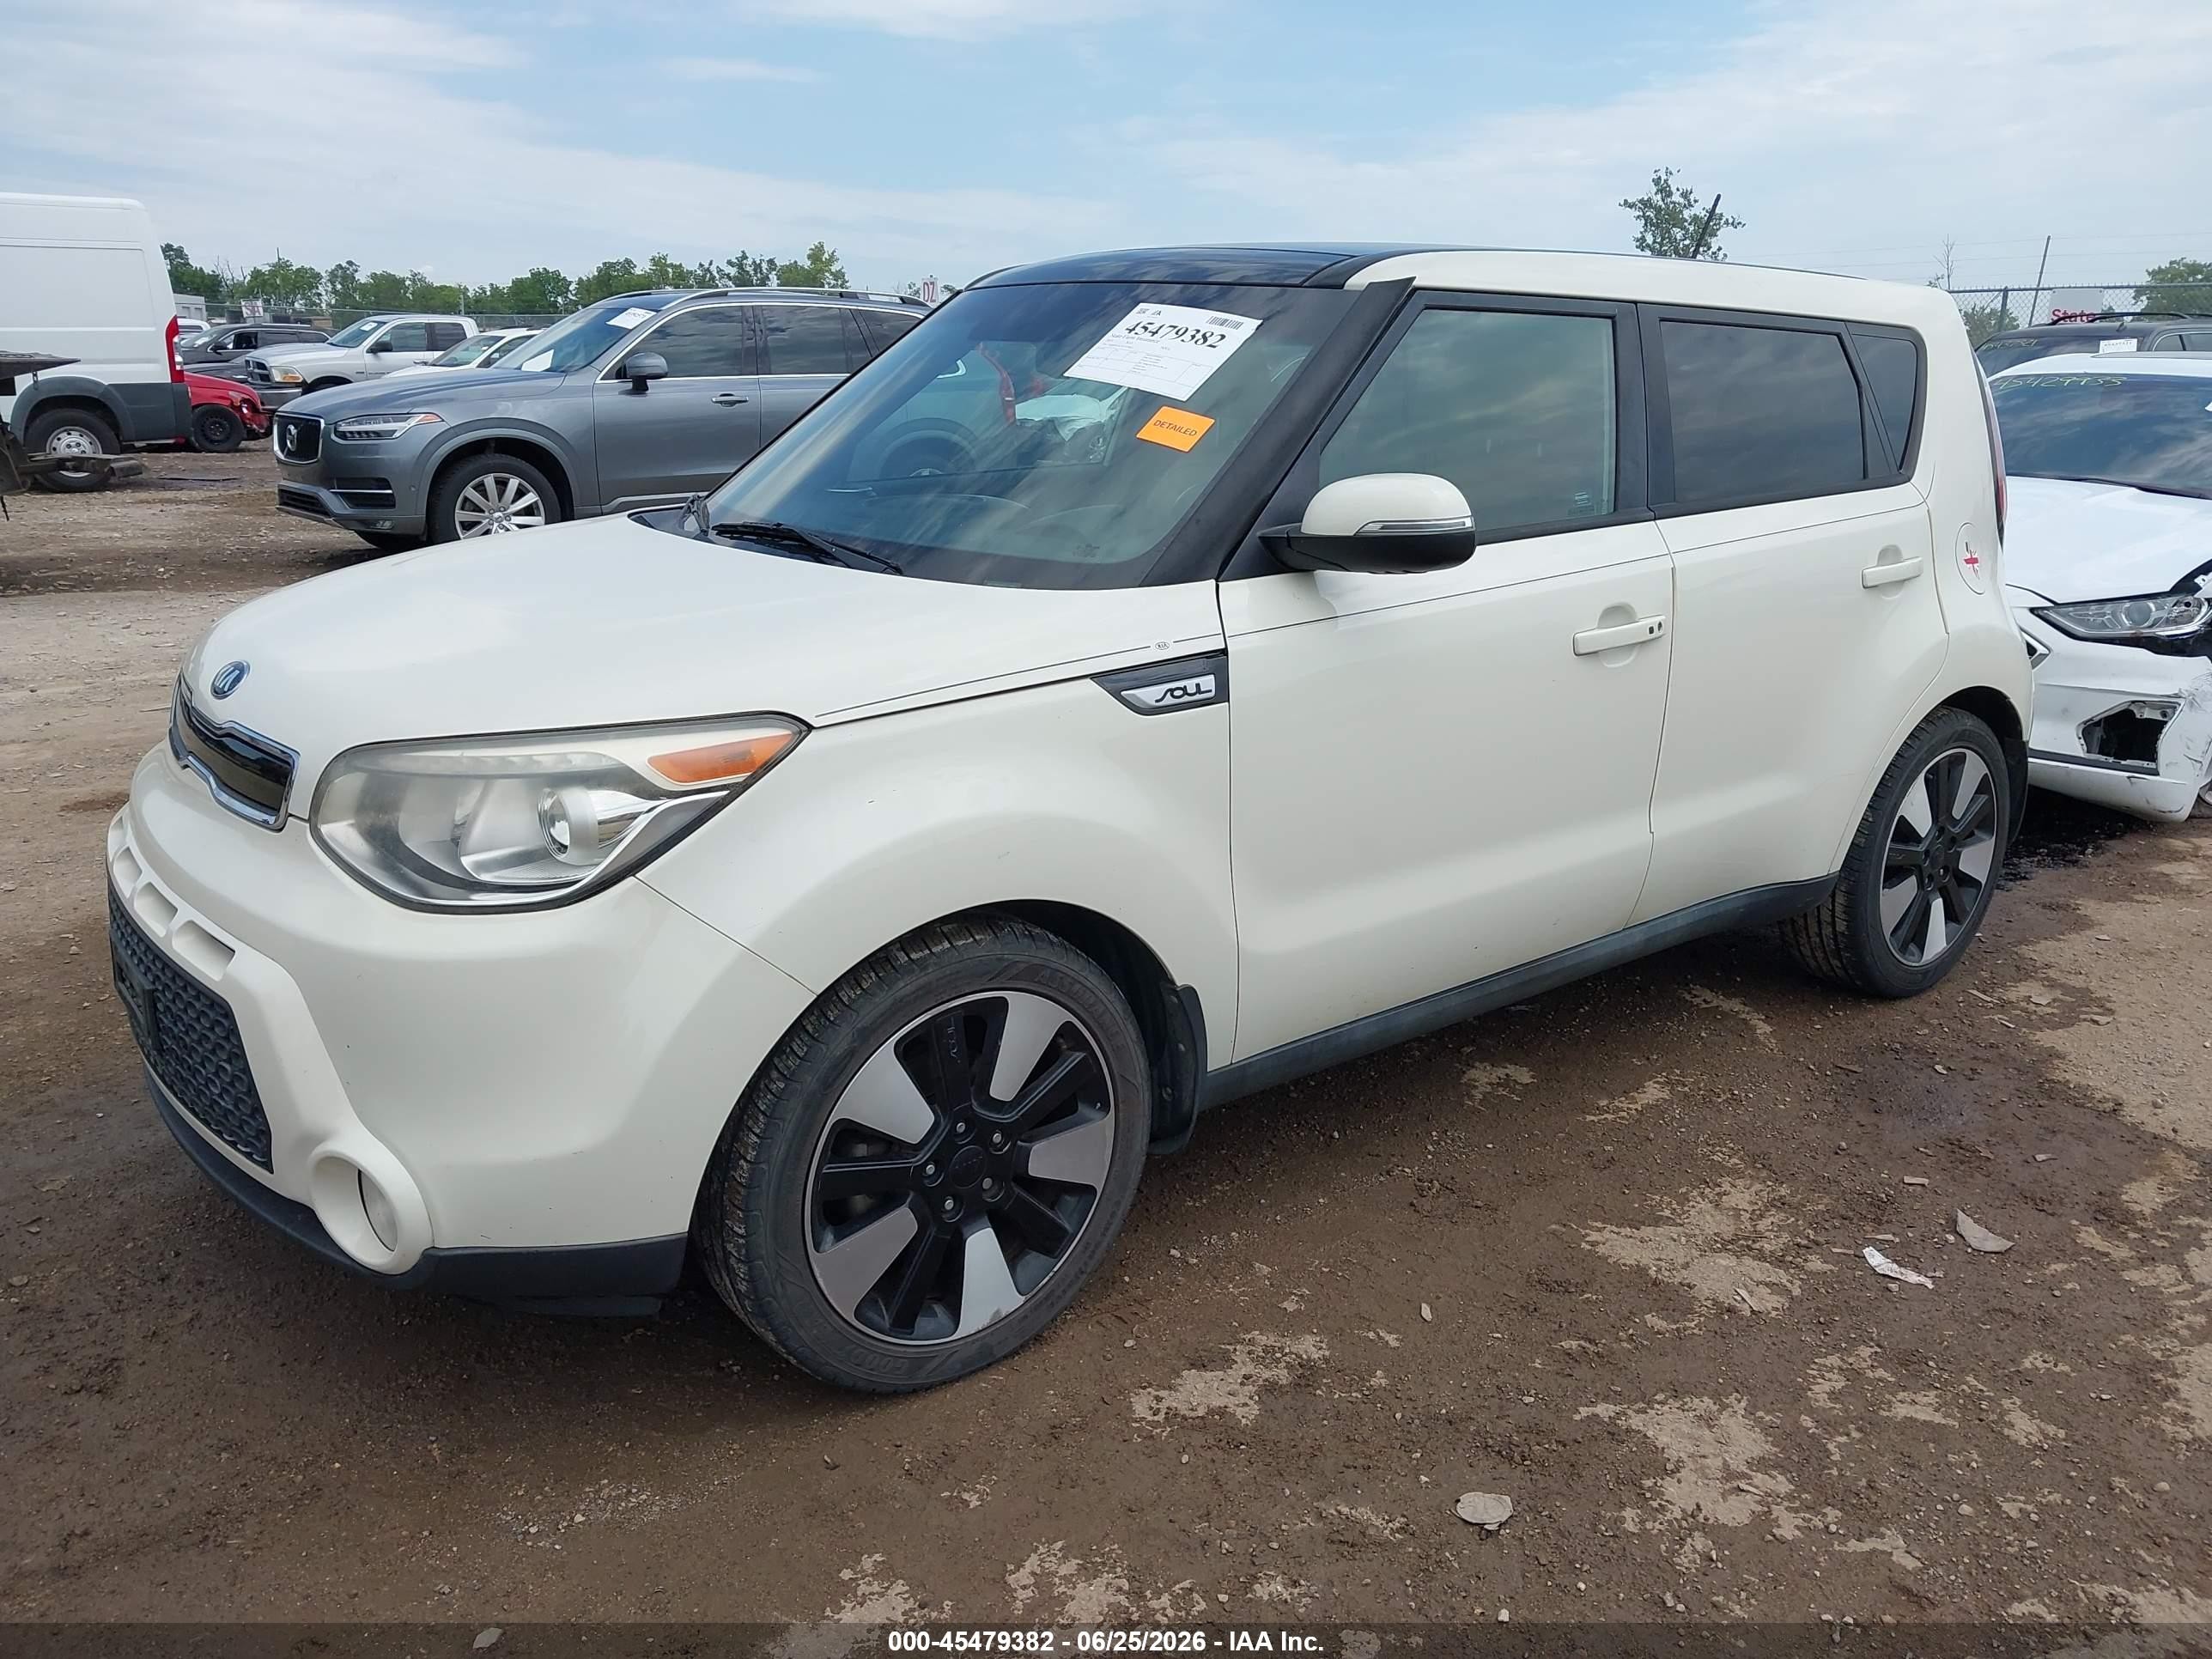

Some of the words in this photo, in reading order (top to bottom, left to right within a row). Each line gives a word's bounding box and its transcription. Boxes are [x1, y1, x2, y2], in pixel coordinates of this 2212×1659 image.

[1124, 320, 1227, 349] 45479382
[1152, 419, 1198, 438] DETAILED
[1154, 683, 1212, 703] SOUL
